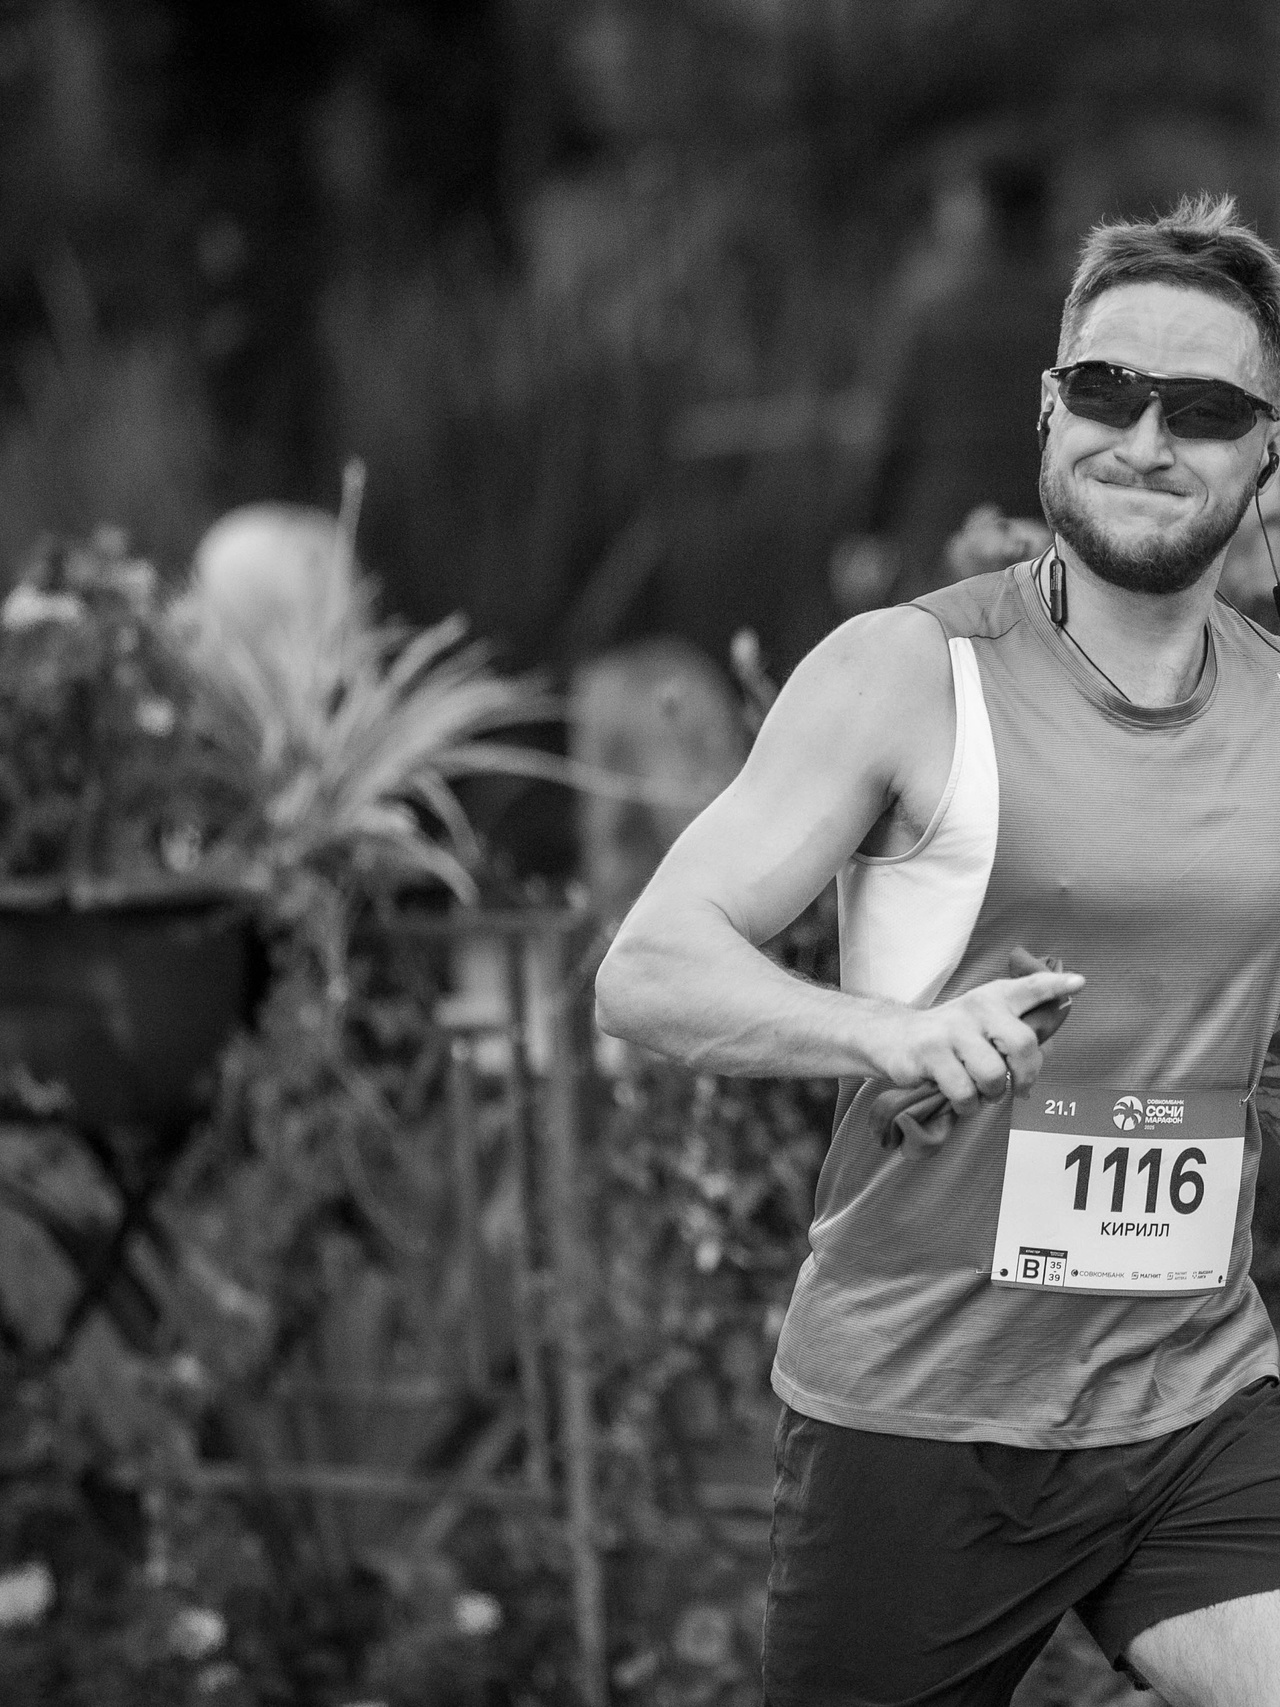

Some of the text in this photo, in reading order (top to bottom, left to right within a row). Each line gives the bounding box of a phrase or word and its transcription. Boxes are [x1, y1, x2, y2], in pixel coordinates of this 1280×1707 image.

[1045, 1099, 1077, 1117] 21.1
[1145, 1105, 1184, 1117] СОЧИ
[1065, 1144, 1207, 1215] 1116
[1100, 1222, 1170, 1237] КИРИЛЛ
[1050, 1261, 1062, 1270] 35
[1048, 1273, 1061, 1282] 39
[1079, 1270, 1125, 1278] СОВКОМБАНК
